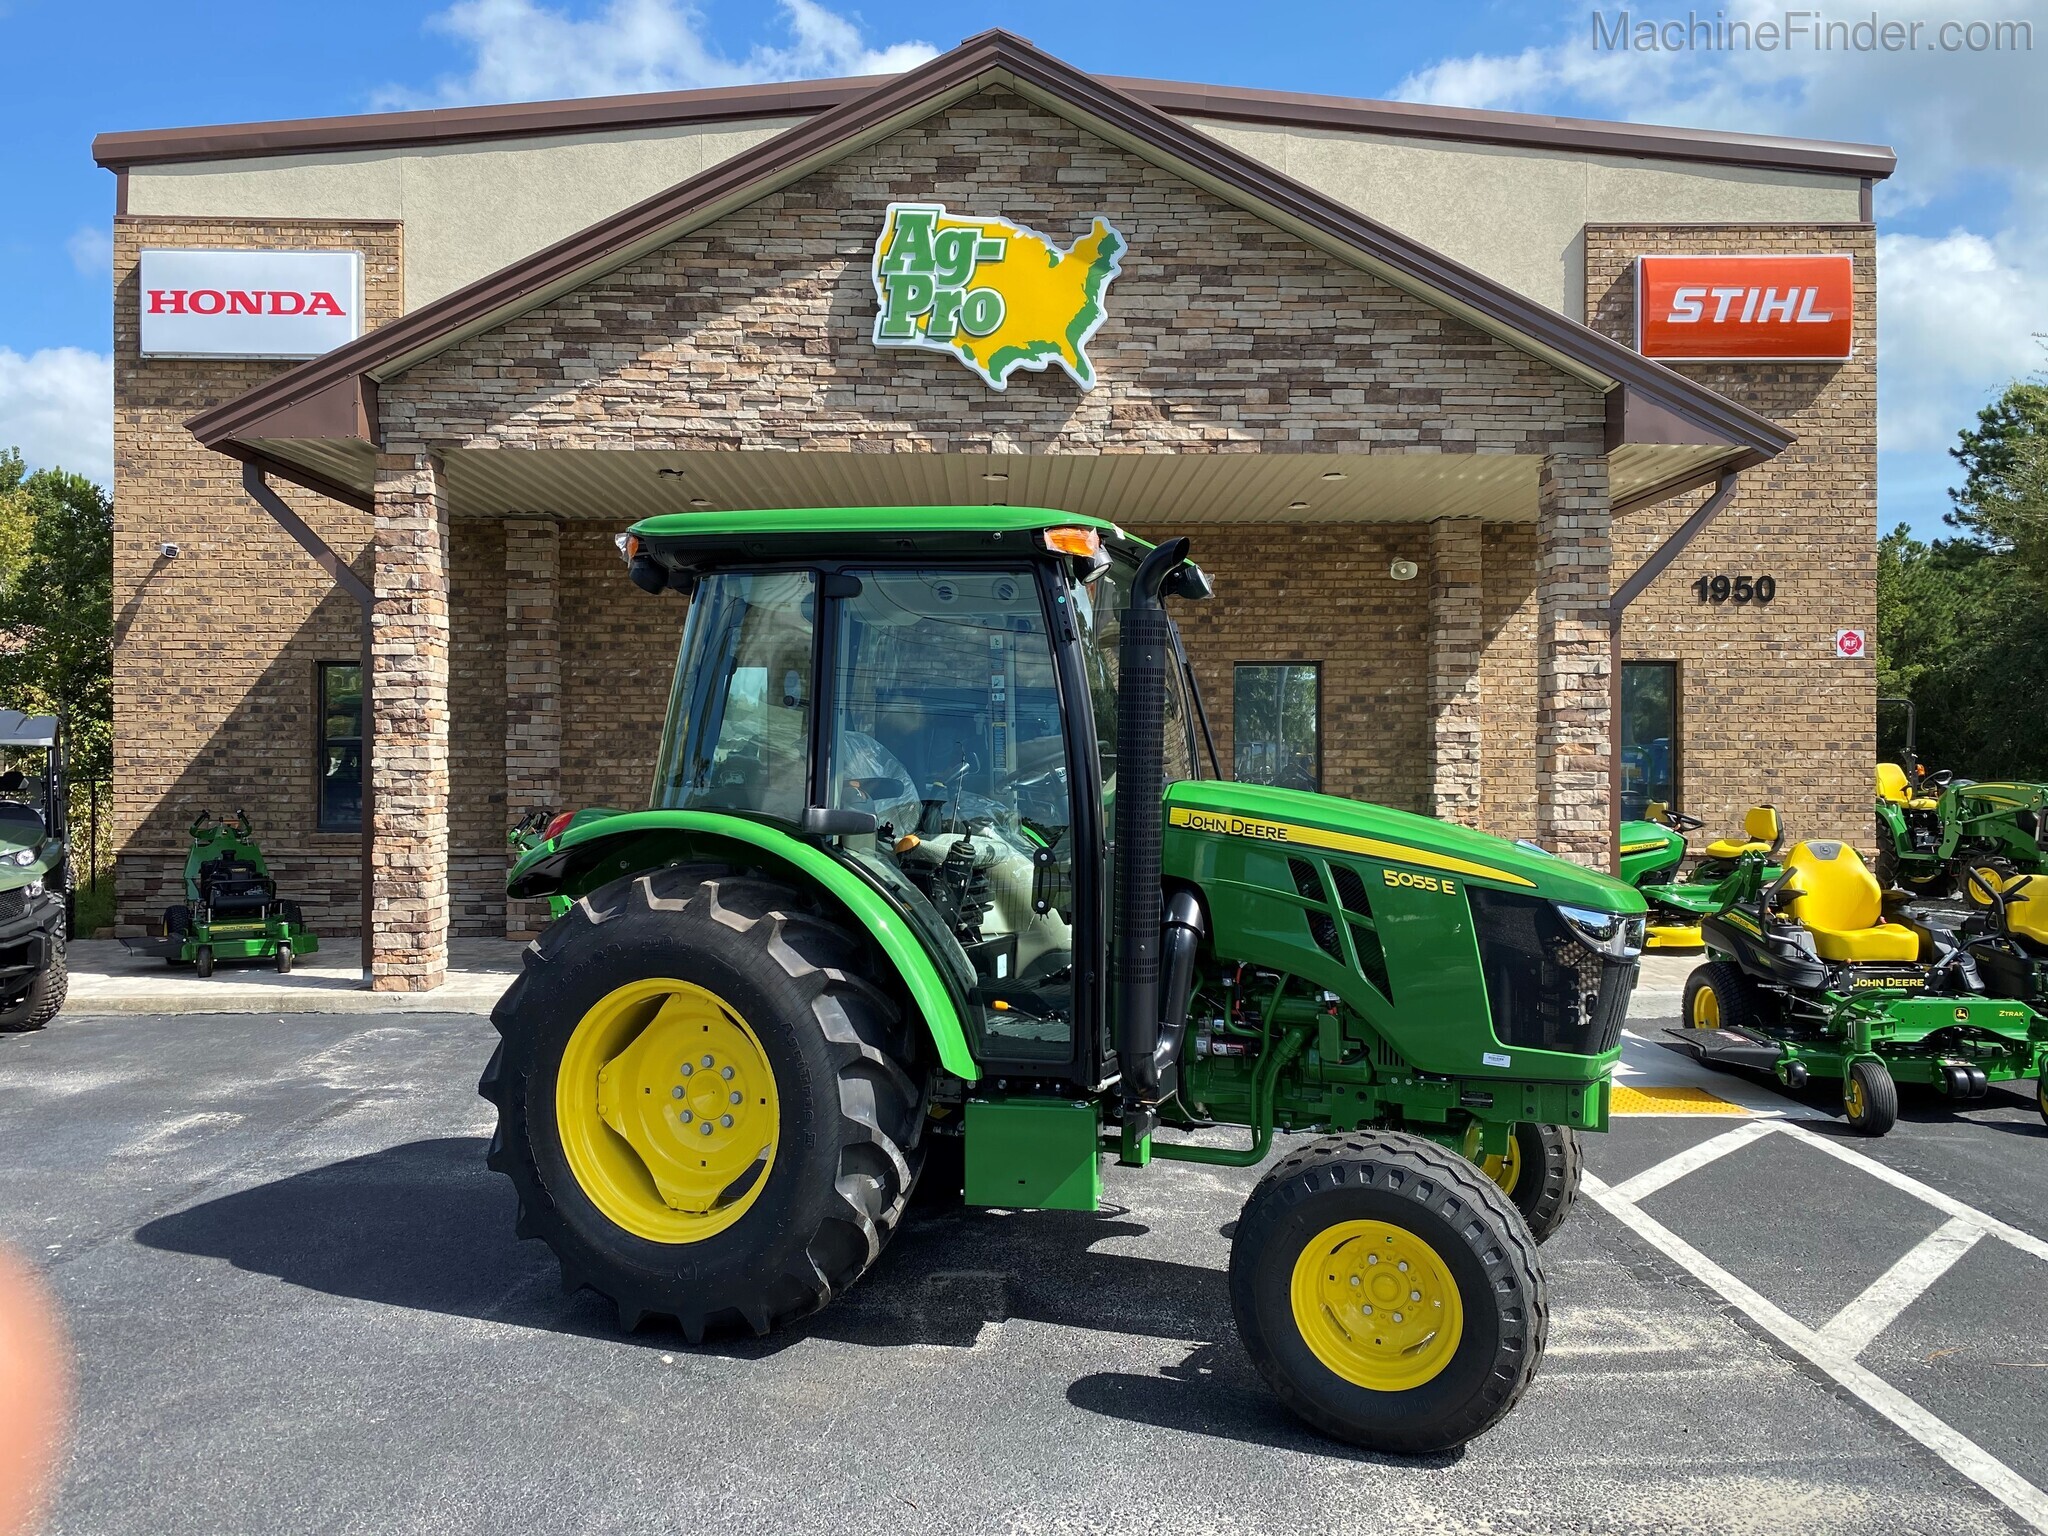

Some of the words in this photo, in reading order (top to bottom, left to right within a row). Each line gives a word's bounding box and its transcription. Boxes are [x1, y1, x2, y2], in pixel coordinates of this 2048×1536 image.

[878, 209, 1008, 287] Ag-
[147, 289, 347, 316] HONDA
[879, 273, 1006, 339] Pro
[1667, 286, 1834, 324] STIHL
[1691, 575, 1776, 603] 1950
[1182, 811, 1228, 833] JOHN
[1230, 818, 1288, 841] DEERE
[1382, 868, 1439, 892] 5055
[1441, 879, 1457, 896] E
[1852, 977, 1884, 988] JOHN
[1886, 977, 1925, 987] DEERE
